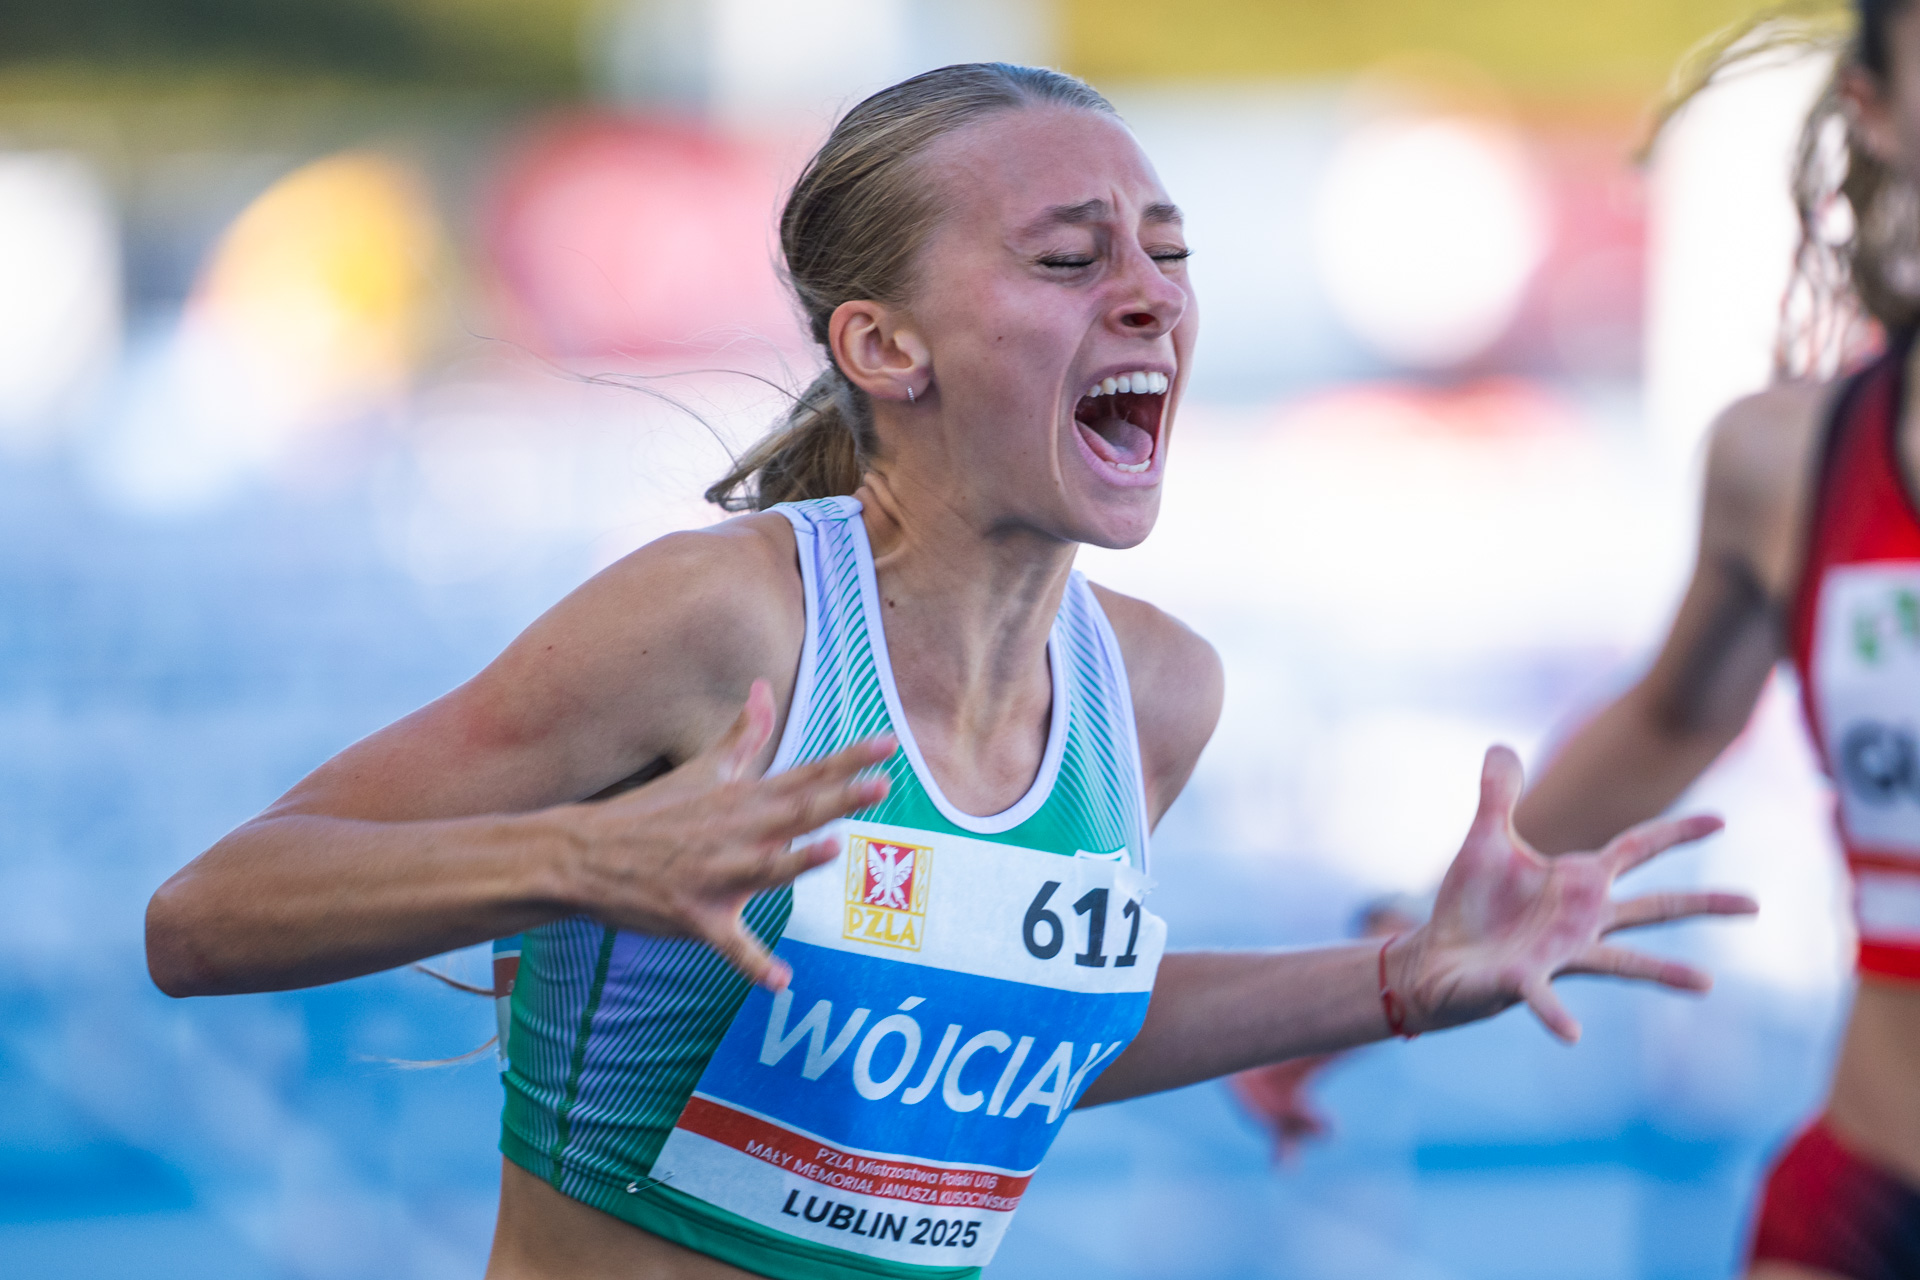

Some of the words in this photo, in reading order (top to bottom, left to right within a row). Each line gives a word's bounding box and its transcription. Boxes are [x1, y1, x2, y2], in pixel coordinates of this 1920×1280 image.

[847, 907, 916, 945] PZLA
[1022, 880, 1141, 968] 611
[758, 987, 1123, 1125] WÓJCIAK
[744, 1139, 793, 1167] MAŁY
[792, 1158, 874, 1194] MEMORIAŁ
[874, 1181, 938, 1203] JANUSZA
[815, 1147, 854, 1171] PZLA
[855, 1159, 938, 1185] Mistrzostwa
[939, 1172, 976, 1186] Polski
[973, 1173, 998, 1190] U16
[781, 1188, 908, 1242] LUBLIN
[909, 1217, 982, 1248] 2025
